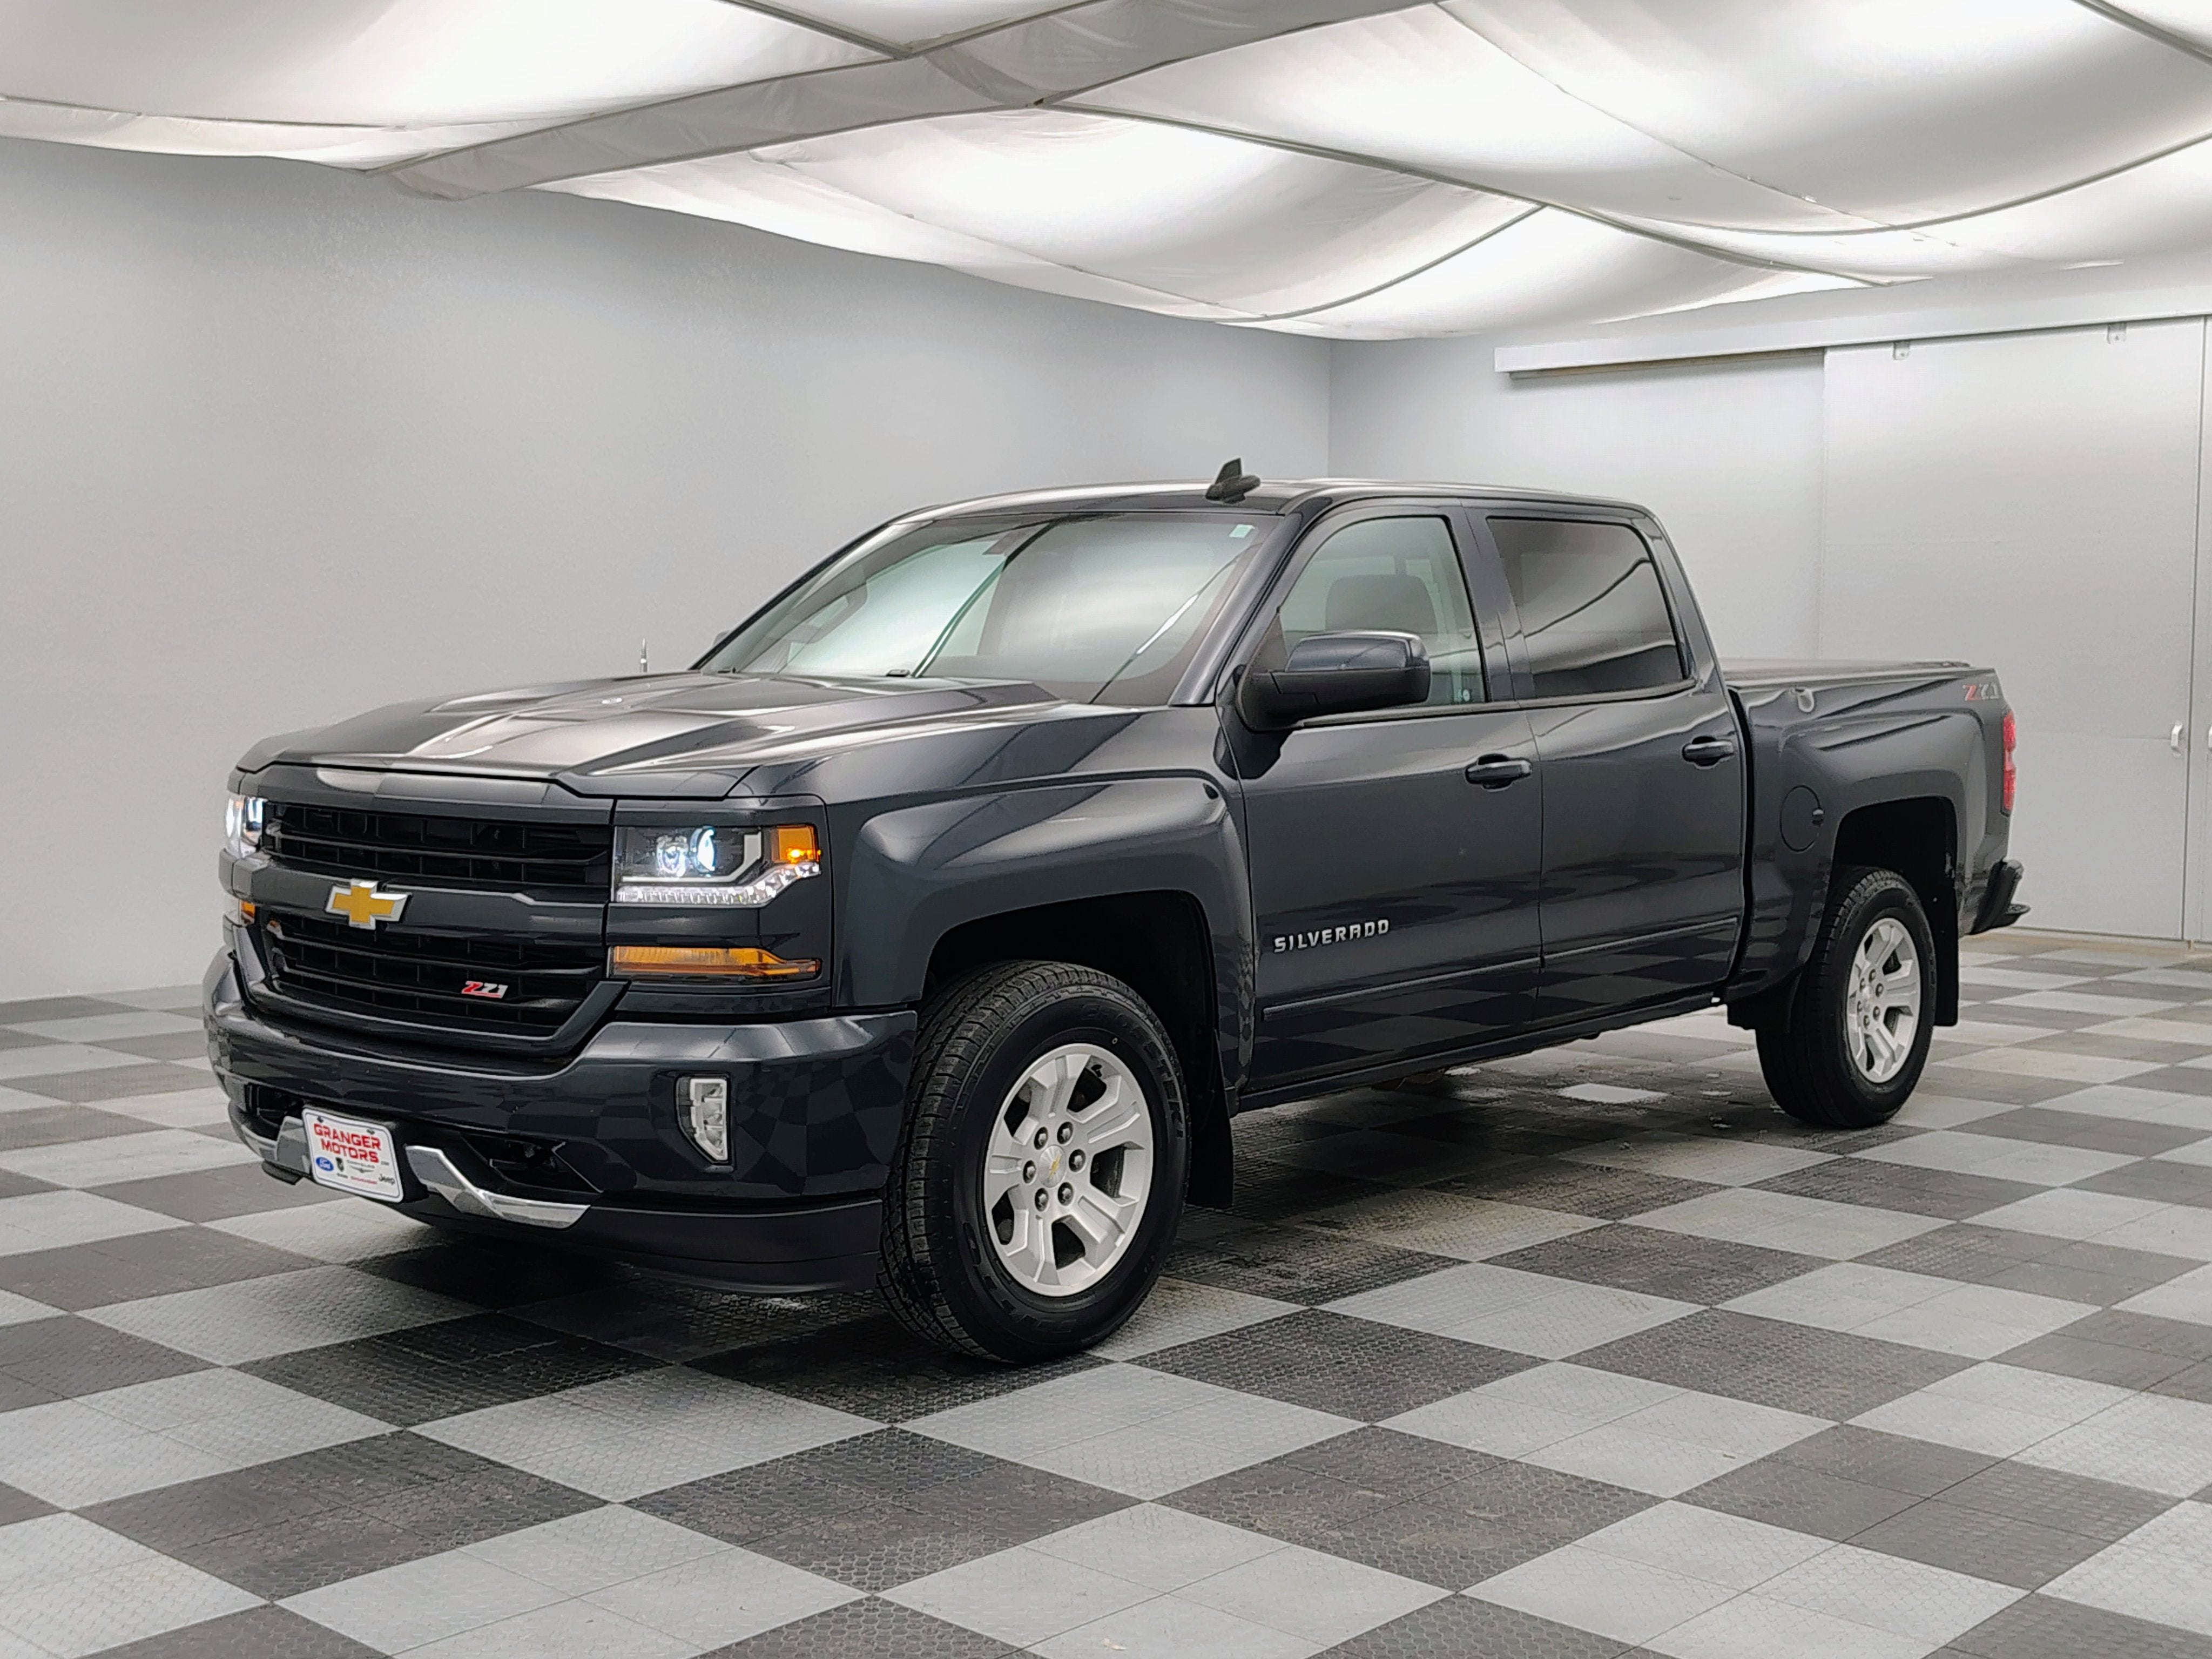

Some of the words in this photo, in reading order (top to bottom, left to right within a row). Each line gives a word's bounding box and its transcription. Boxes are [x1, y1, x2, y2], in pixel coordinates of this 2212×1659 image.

[1273, 919, 1390, 953] SILVERADO
[461, 980, 508, 999] Z71
[313, 1123, 382, 1151] GRANGER
[320, 1138, 379, 1163] MOTORS
